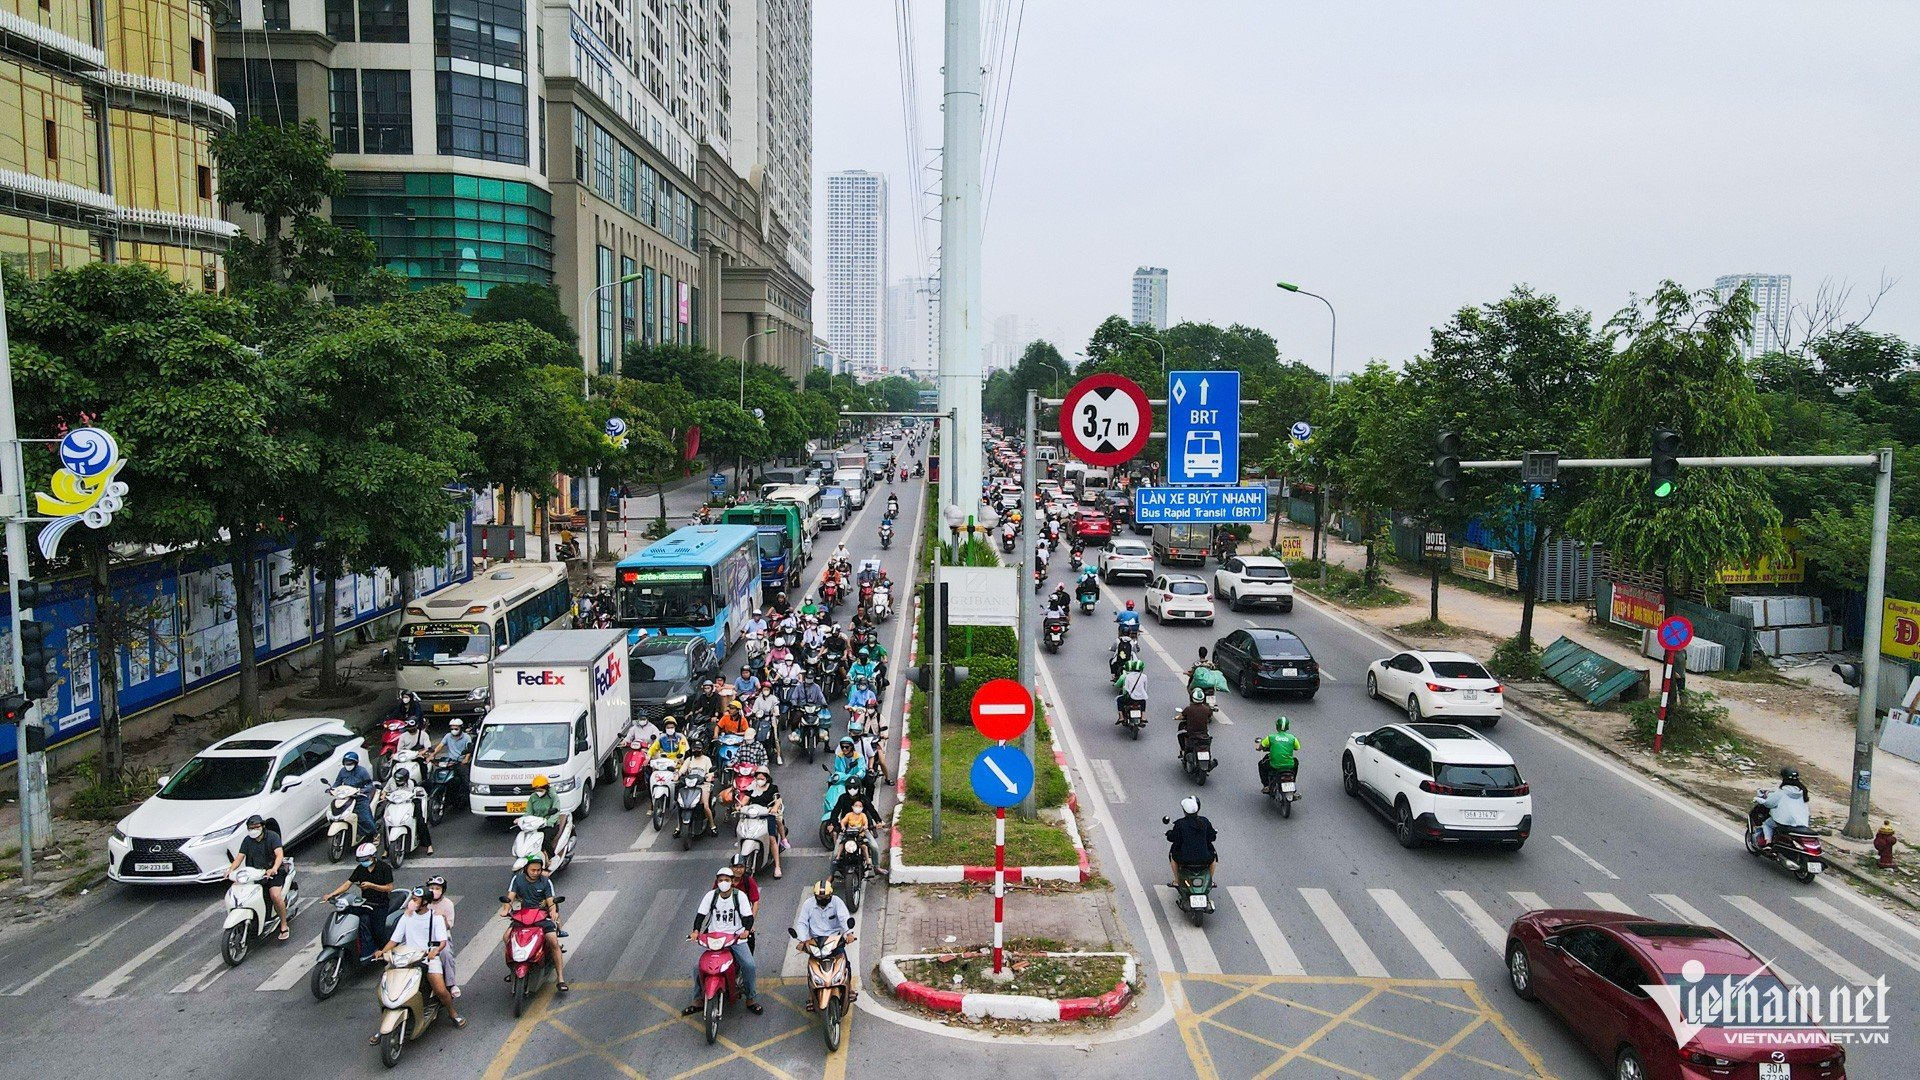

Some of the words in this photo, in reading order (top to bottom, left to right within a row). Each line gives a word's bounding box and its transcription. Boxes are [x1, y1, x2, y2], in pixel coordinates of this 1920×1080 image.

[1083, 404, 1112, 441] 3,7
[1117, 421, 1129, 436] m
[1190, 409, 1219, 424] BRT
[1141, 490, 1166, 504] LÀN
[1169, 493, 1185, 504] XE
[1188, 490, 1219, 504] BUÝT
[1222, 492, 1262, 504] NHANH
[1141, 508, 1161, 518] Bus
[1163, 507, 1191, 519] Rapid
[1194, 507, 1227, 518] Transit
[1231, 506, 1261, 519] (BRT)
[1425, 532, 1447, 545] HOTEL
[1894, 616, 1920, 646] Đ
[517, 670, 565, 686] FedEx
[594, 652, 622, 701] FedEx
[1766, 1063, 1783, 1073] 30A
